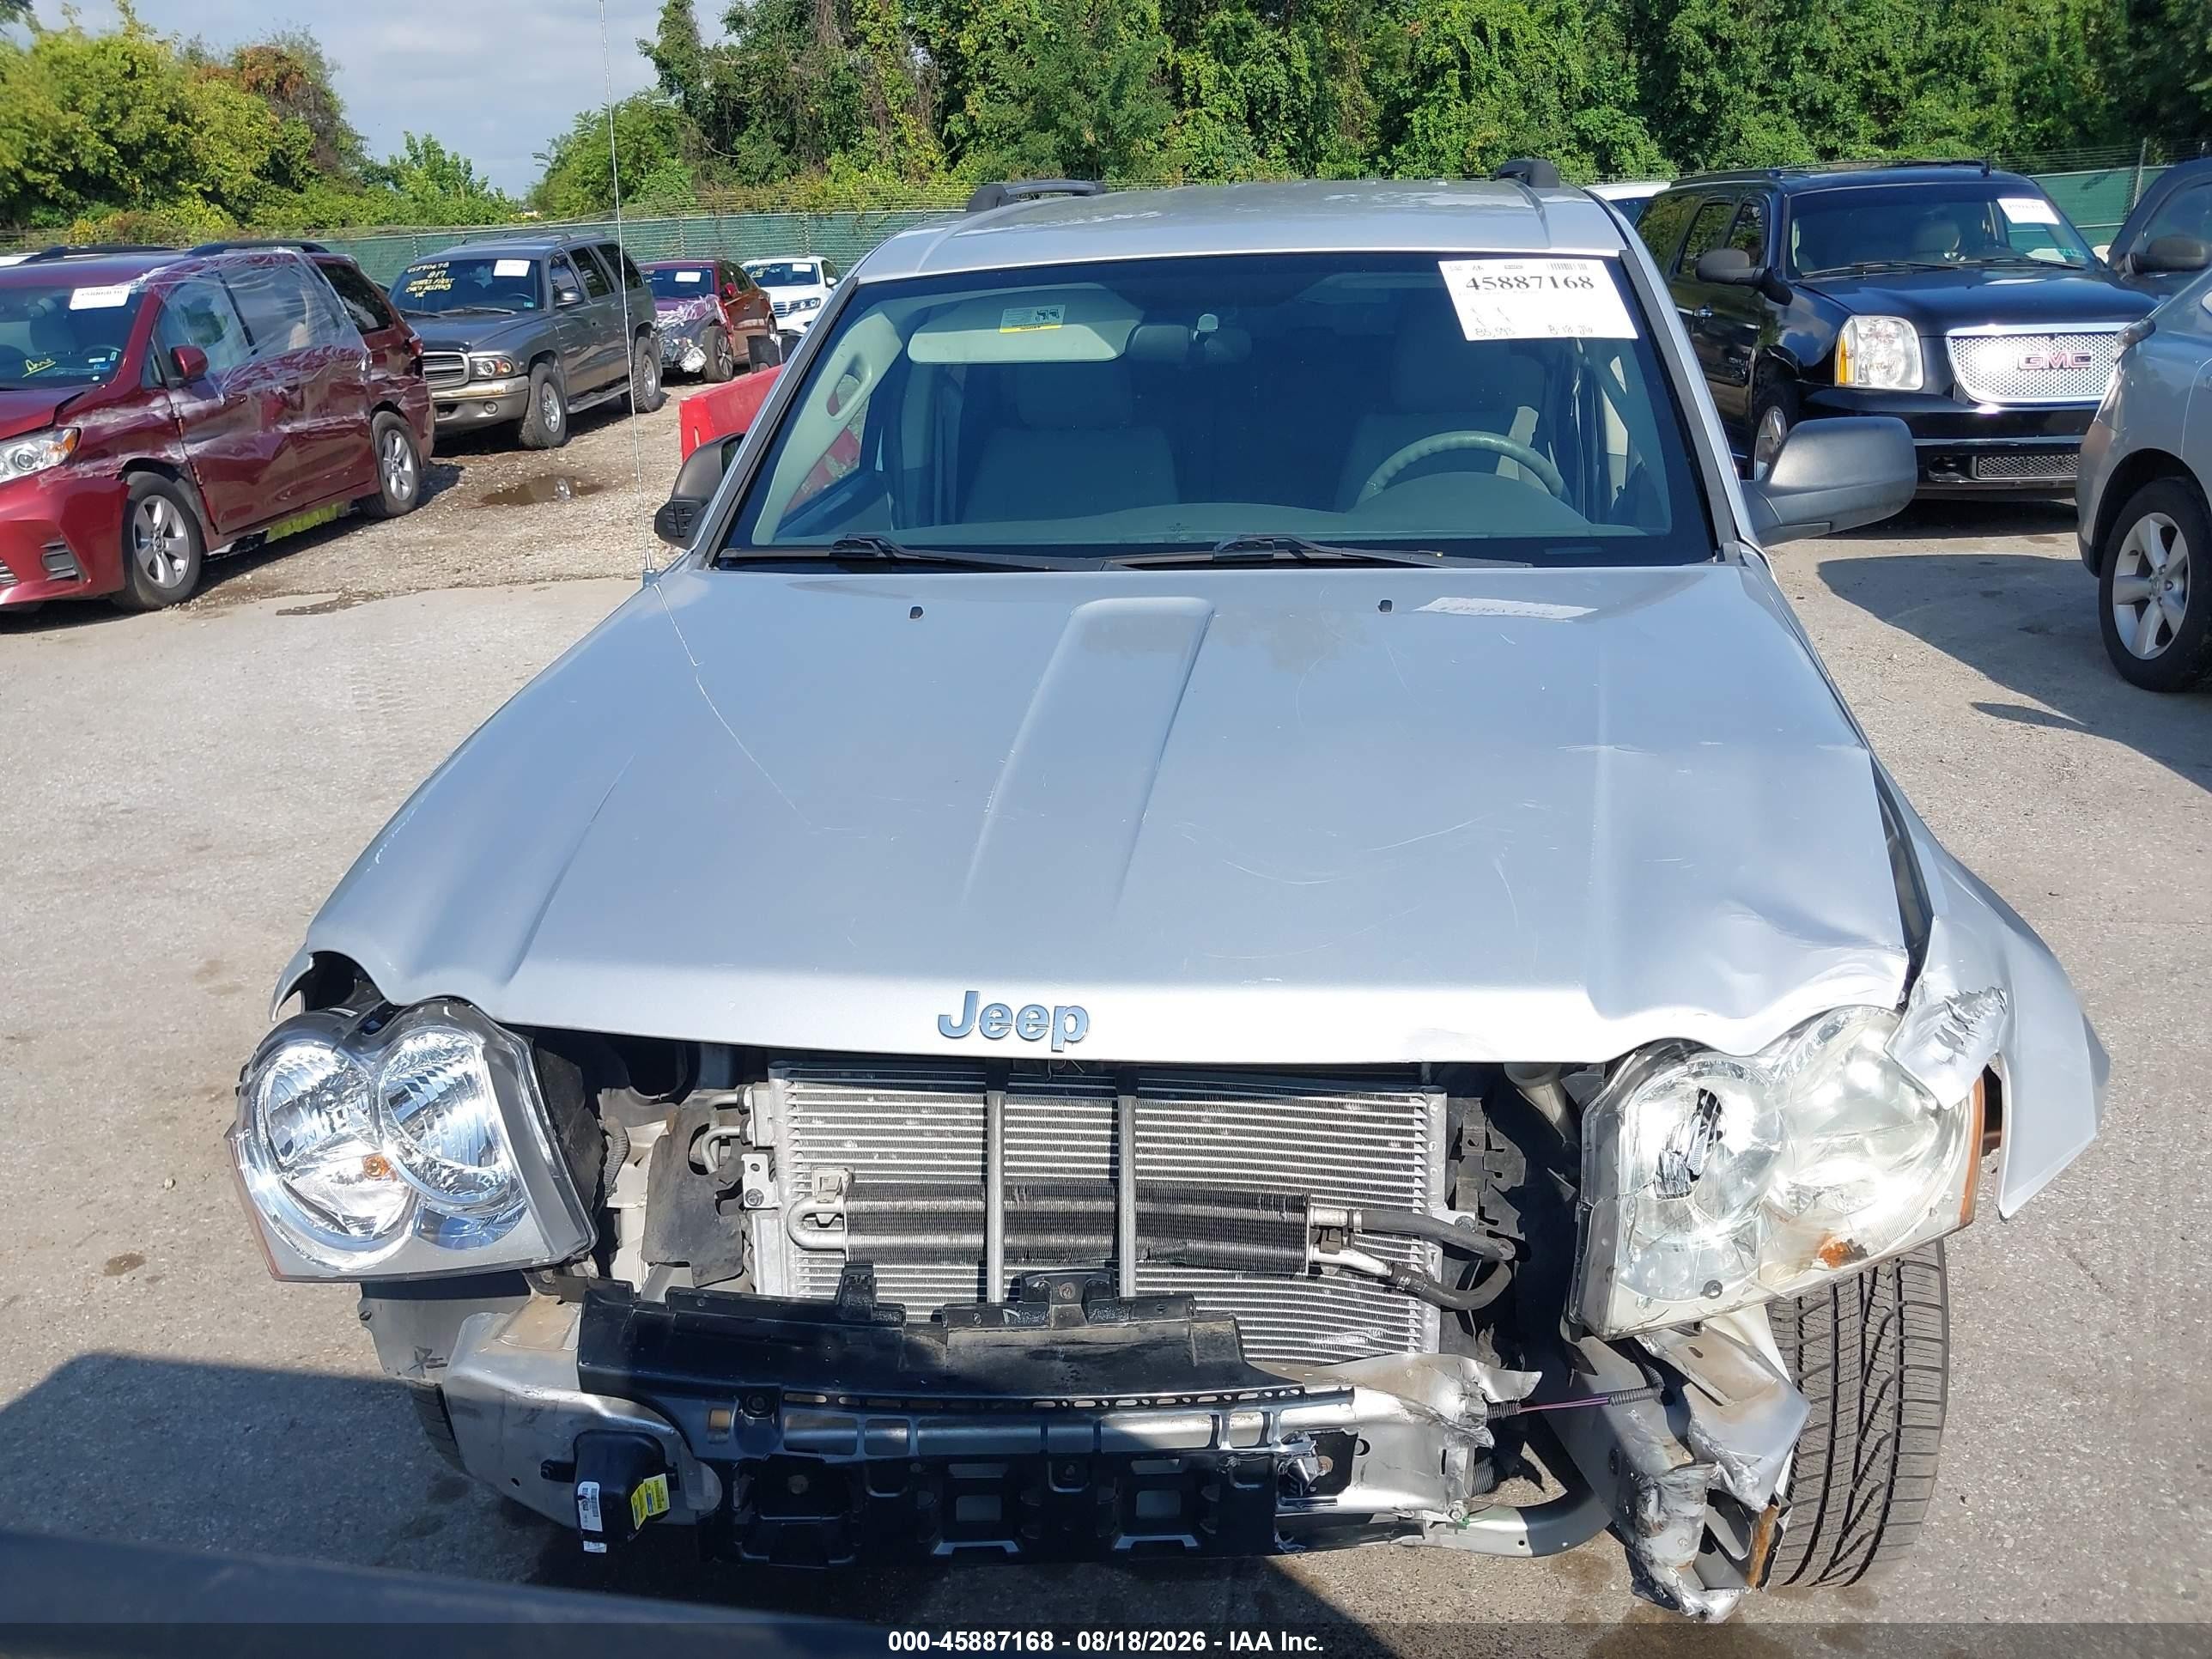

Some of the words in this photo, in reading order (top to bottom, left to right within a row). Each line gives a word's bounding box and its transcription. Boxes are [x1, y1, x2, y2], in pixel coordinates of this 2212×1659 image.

[1466, 275, 1595, 290] 45887168
[2018, 350, 2092, 370] GMC
[938, 990, 1090, 1052] Jeep
